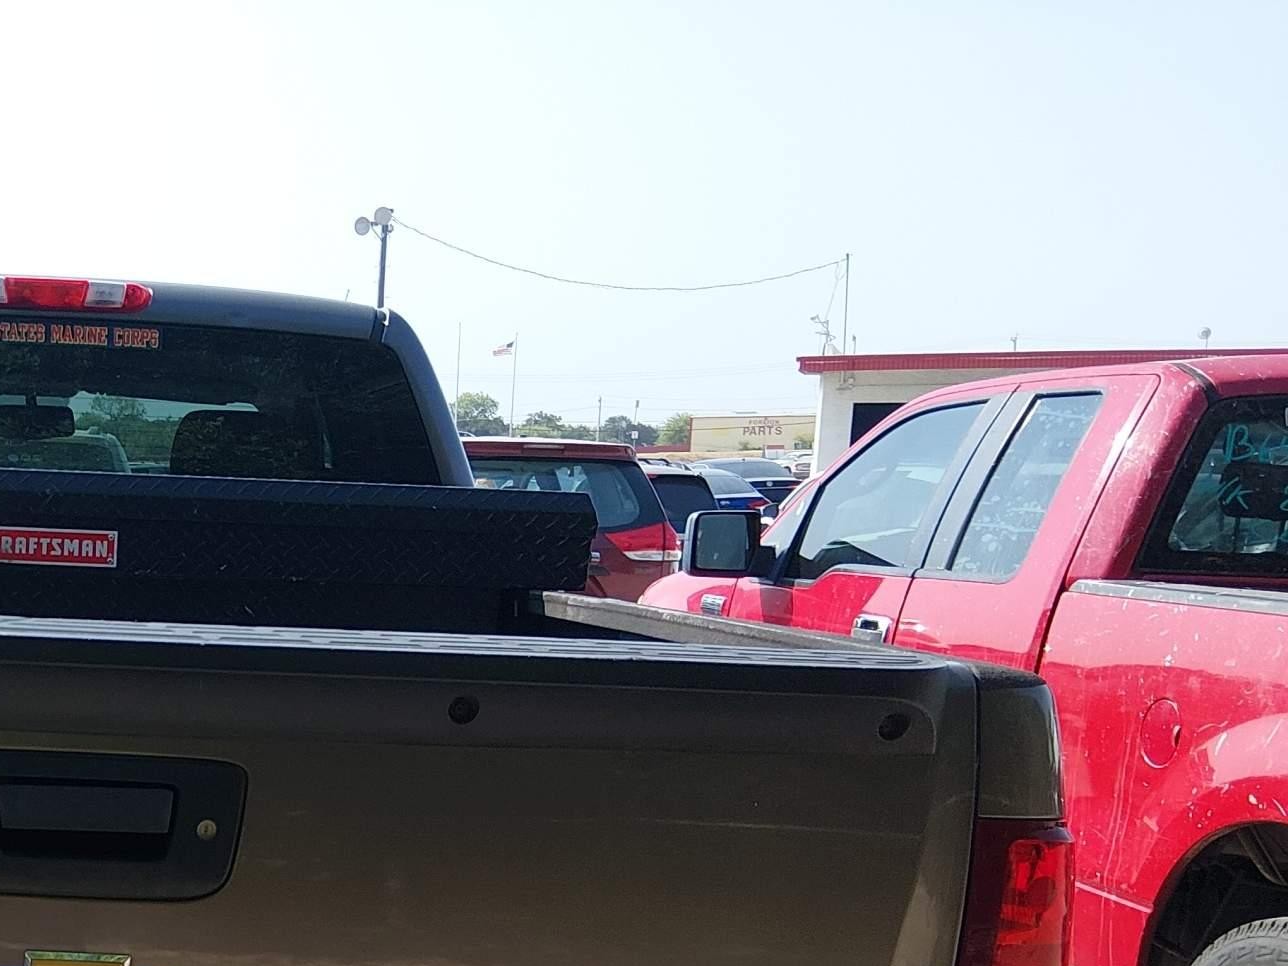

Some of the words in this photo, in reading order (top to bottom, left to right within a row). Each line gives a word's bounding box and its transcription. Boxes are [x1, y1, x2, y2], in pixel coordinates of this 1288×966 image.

[50, 324, 108, 346] MARINE
[113, 327, 160, 349] CORPS
[742, 426, 783, 436] PARTS
